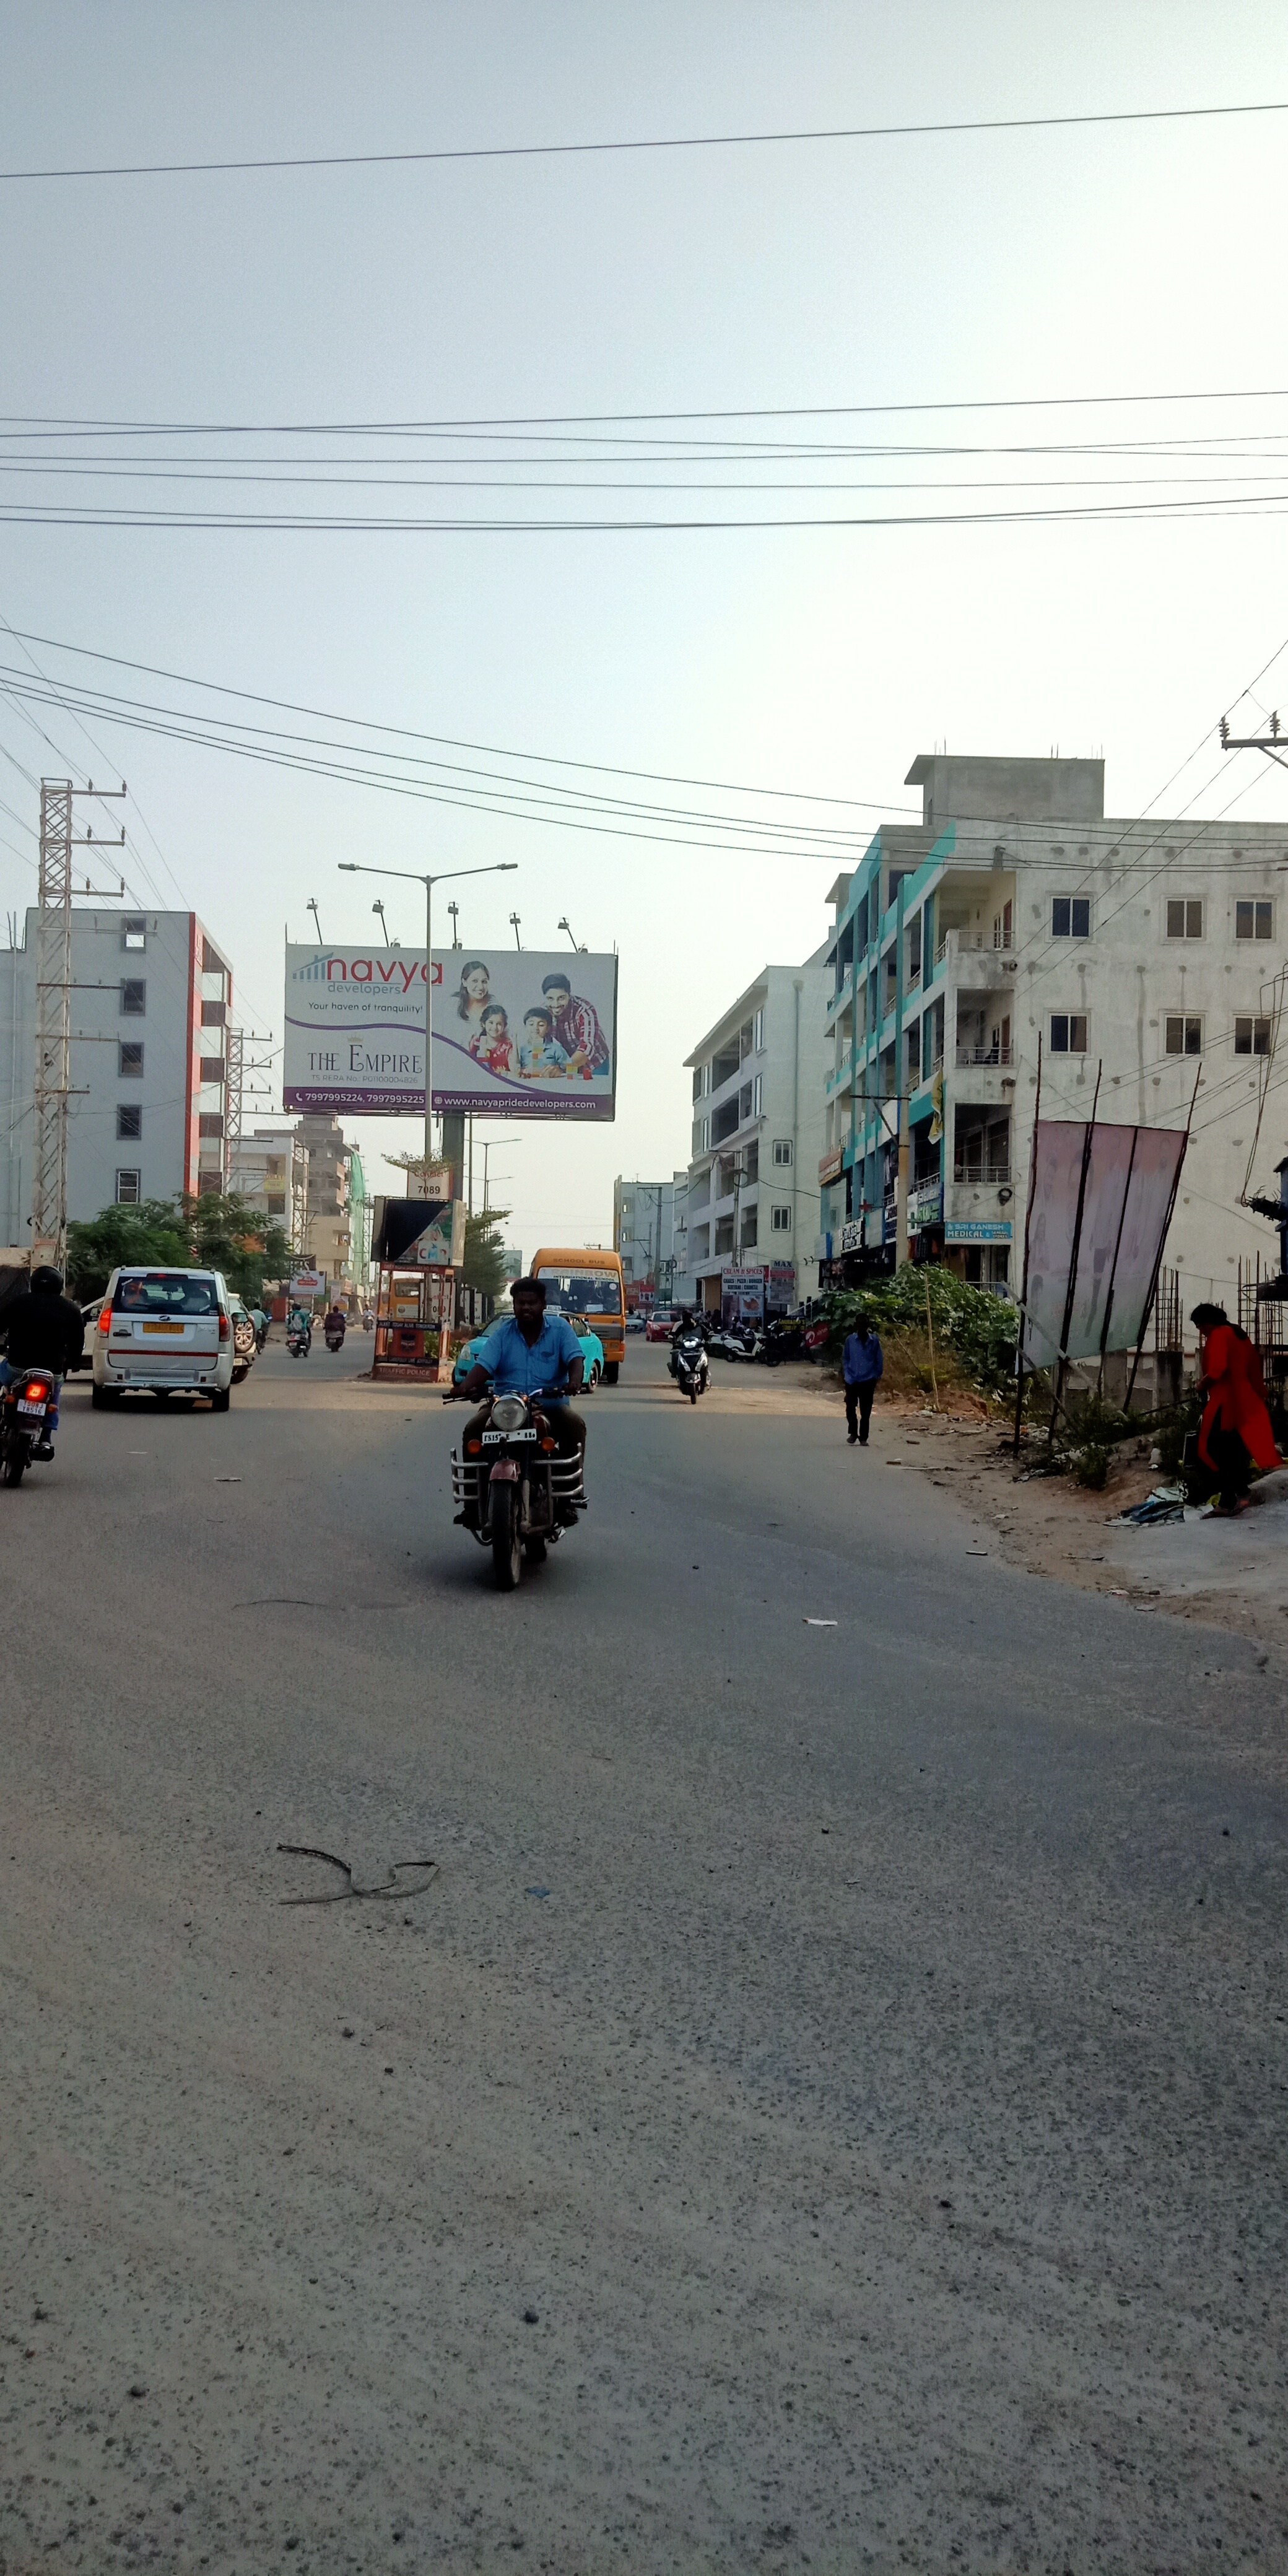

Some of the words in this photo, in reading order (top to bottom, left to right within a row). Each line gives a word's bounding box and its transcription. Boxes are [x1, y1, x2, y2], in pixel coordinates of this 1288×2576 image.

[327, 959, 443, 993] navya
[328, 982, 401, 996] developers
[308, 1002, 329, 1010] Your
[331, 1002, 359, 1011] haven
[374, 1004, 423, 1014] tranquility!
[308, 1052, 340, 1071] THE
[305, 1092, 365, 1103] 7997995224,
[367, 1094, 425, 1103] 7997995225
[443, 1097, 596, 1110] www.navyapridedevelopers.com
[417, 1185, 440, 1194] 7089
